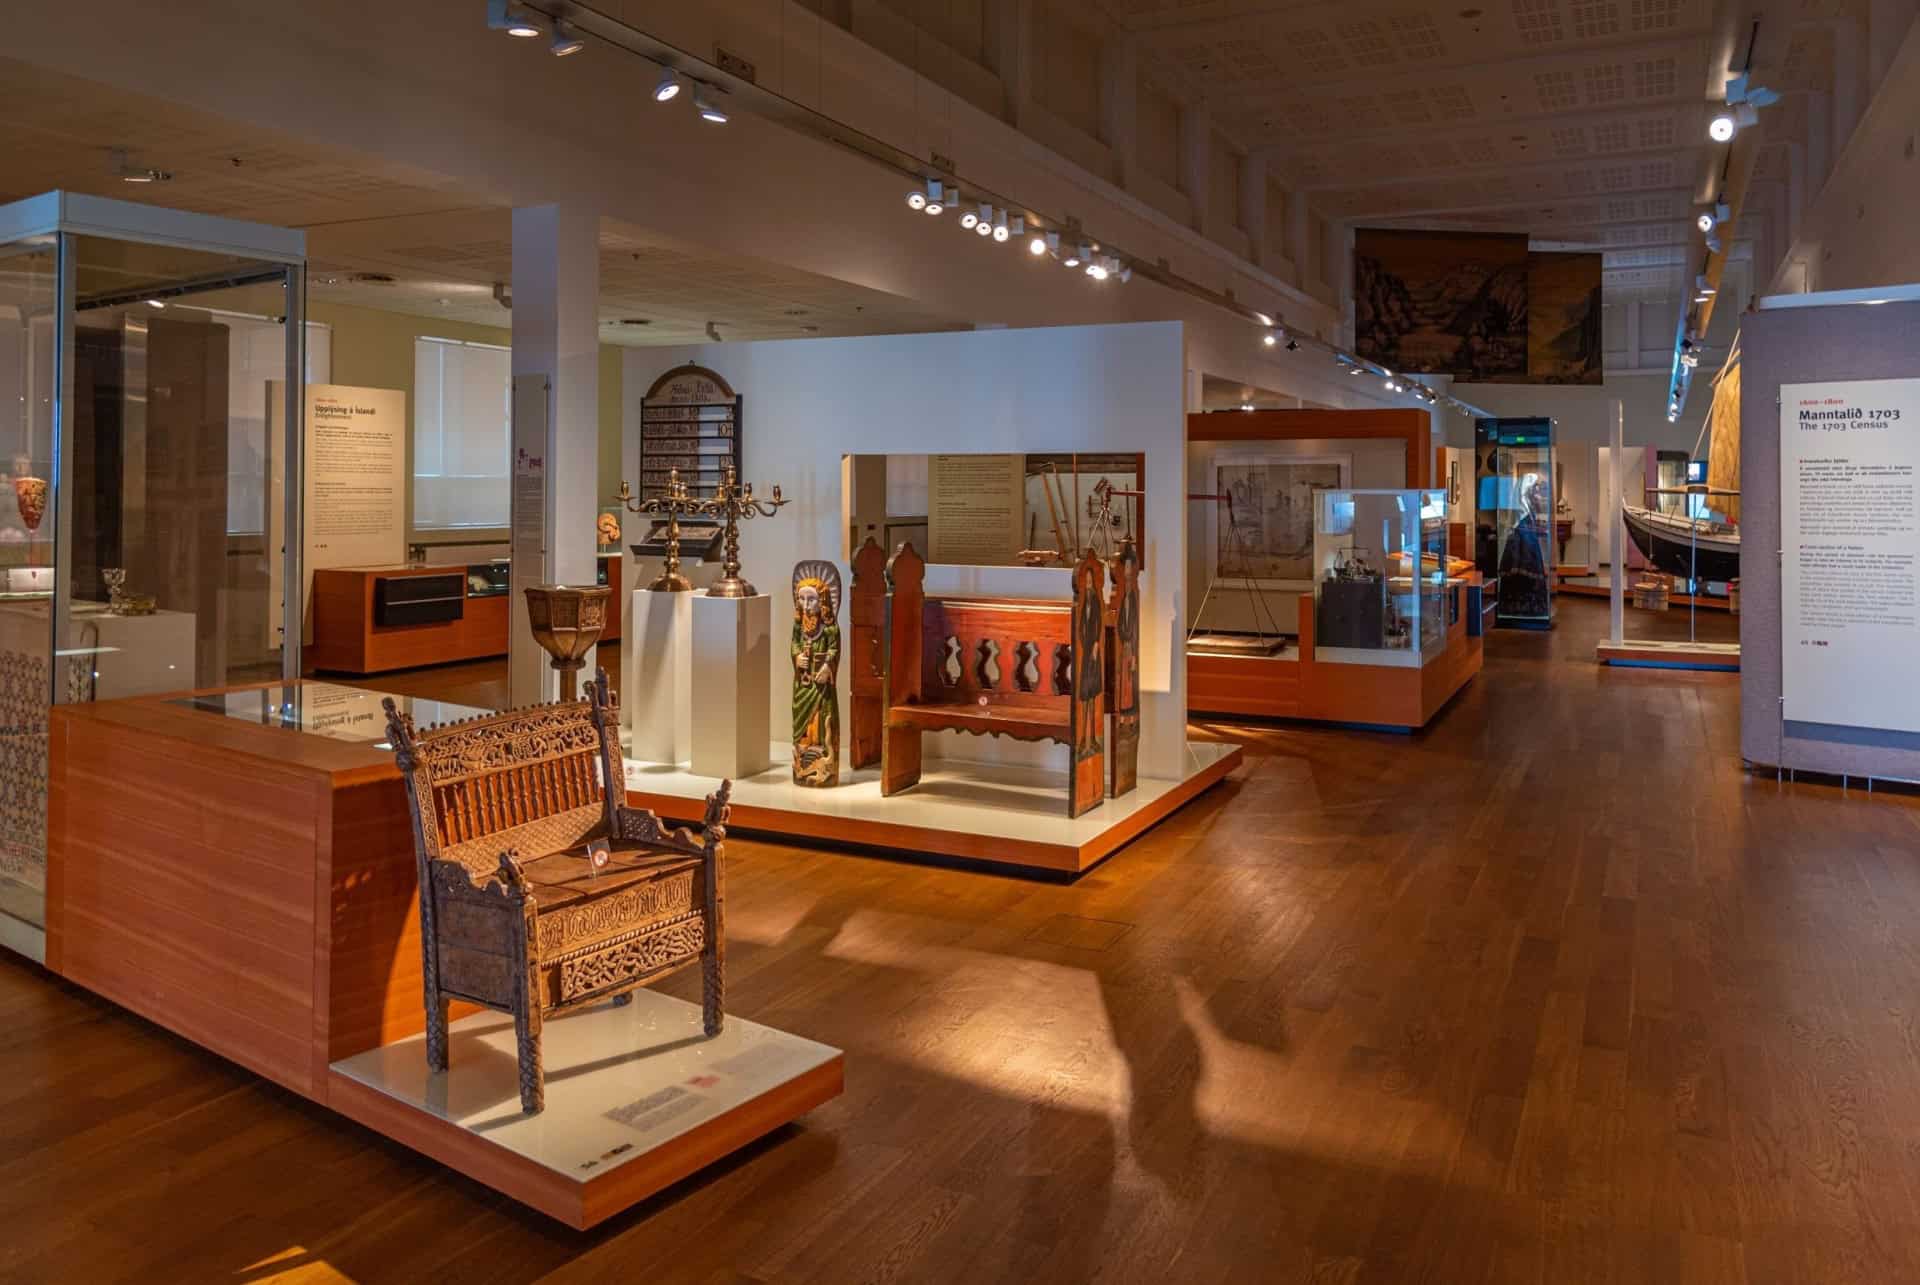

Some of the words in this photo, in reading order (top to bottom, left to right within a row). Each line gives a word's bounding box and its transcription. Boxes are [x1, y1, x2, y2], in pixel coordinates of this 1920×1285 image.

[1799, 408, 1863, 421] Manntalið
[1869, 409, 1901, 421] 1703
[1799, 421, 1818, 431] The
[1822, 422, 1847, 432] 1703
[1850, 420, 1889, 430] Census
